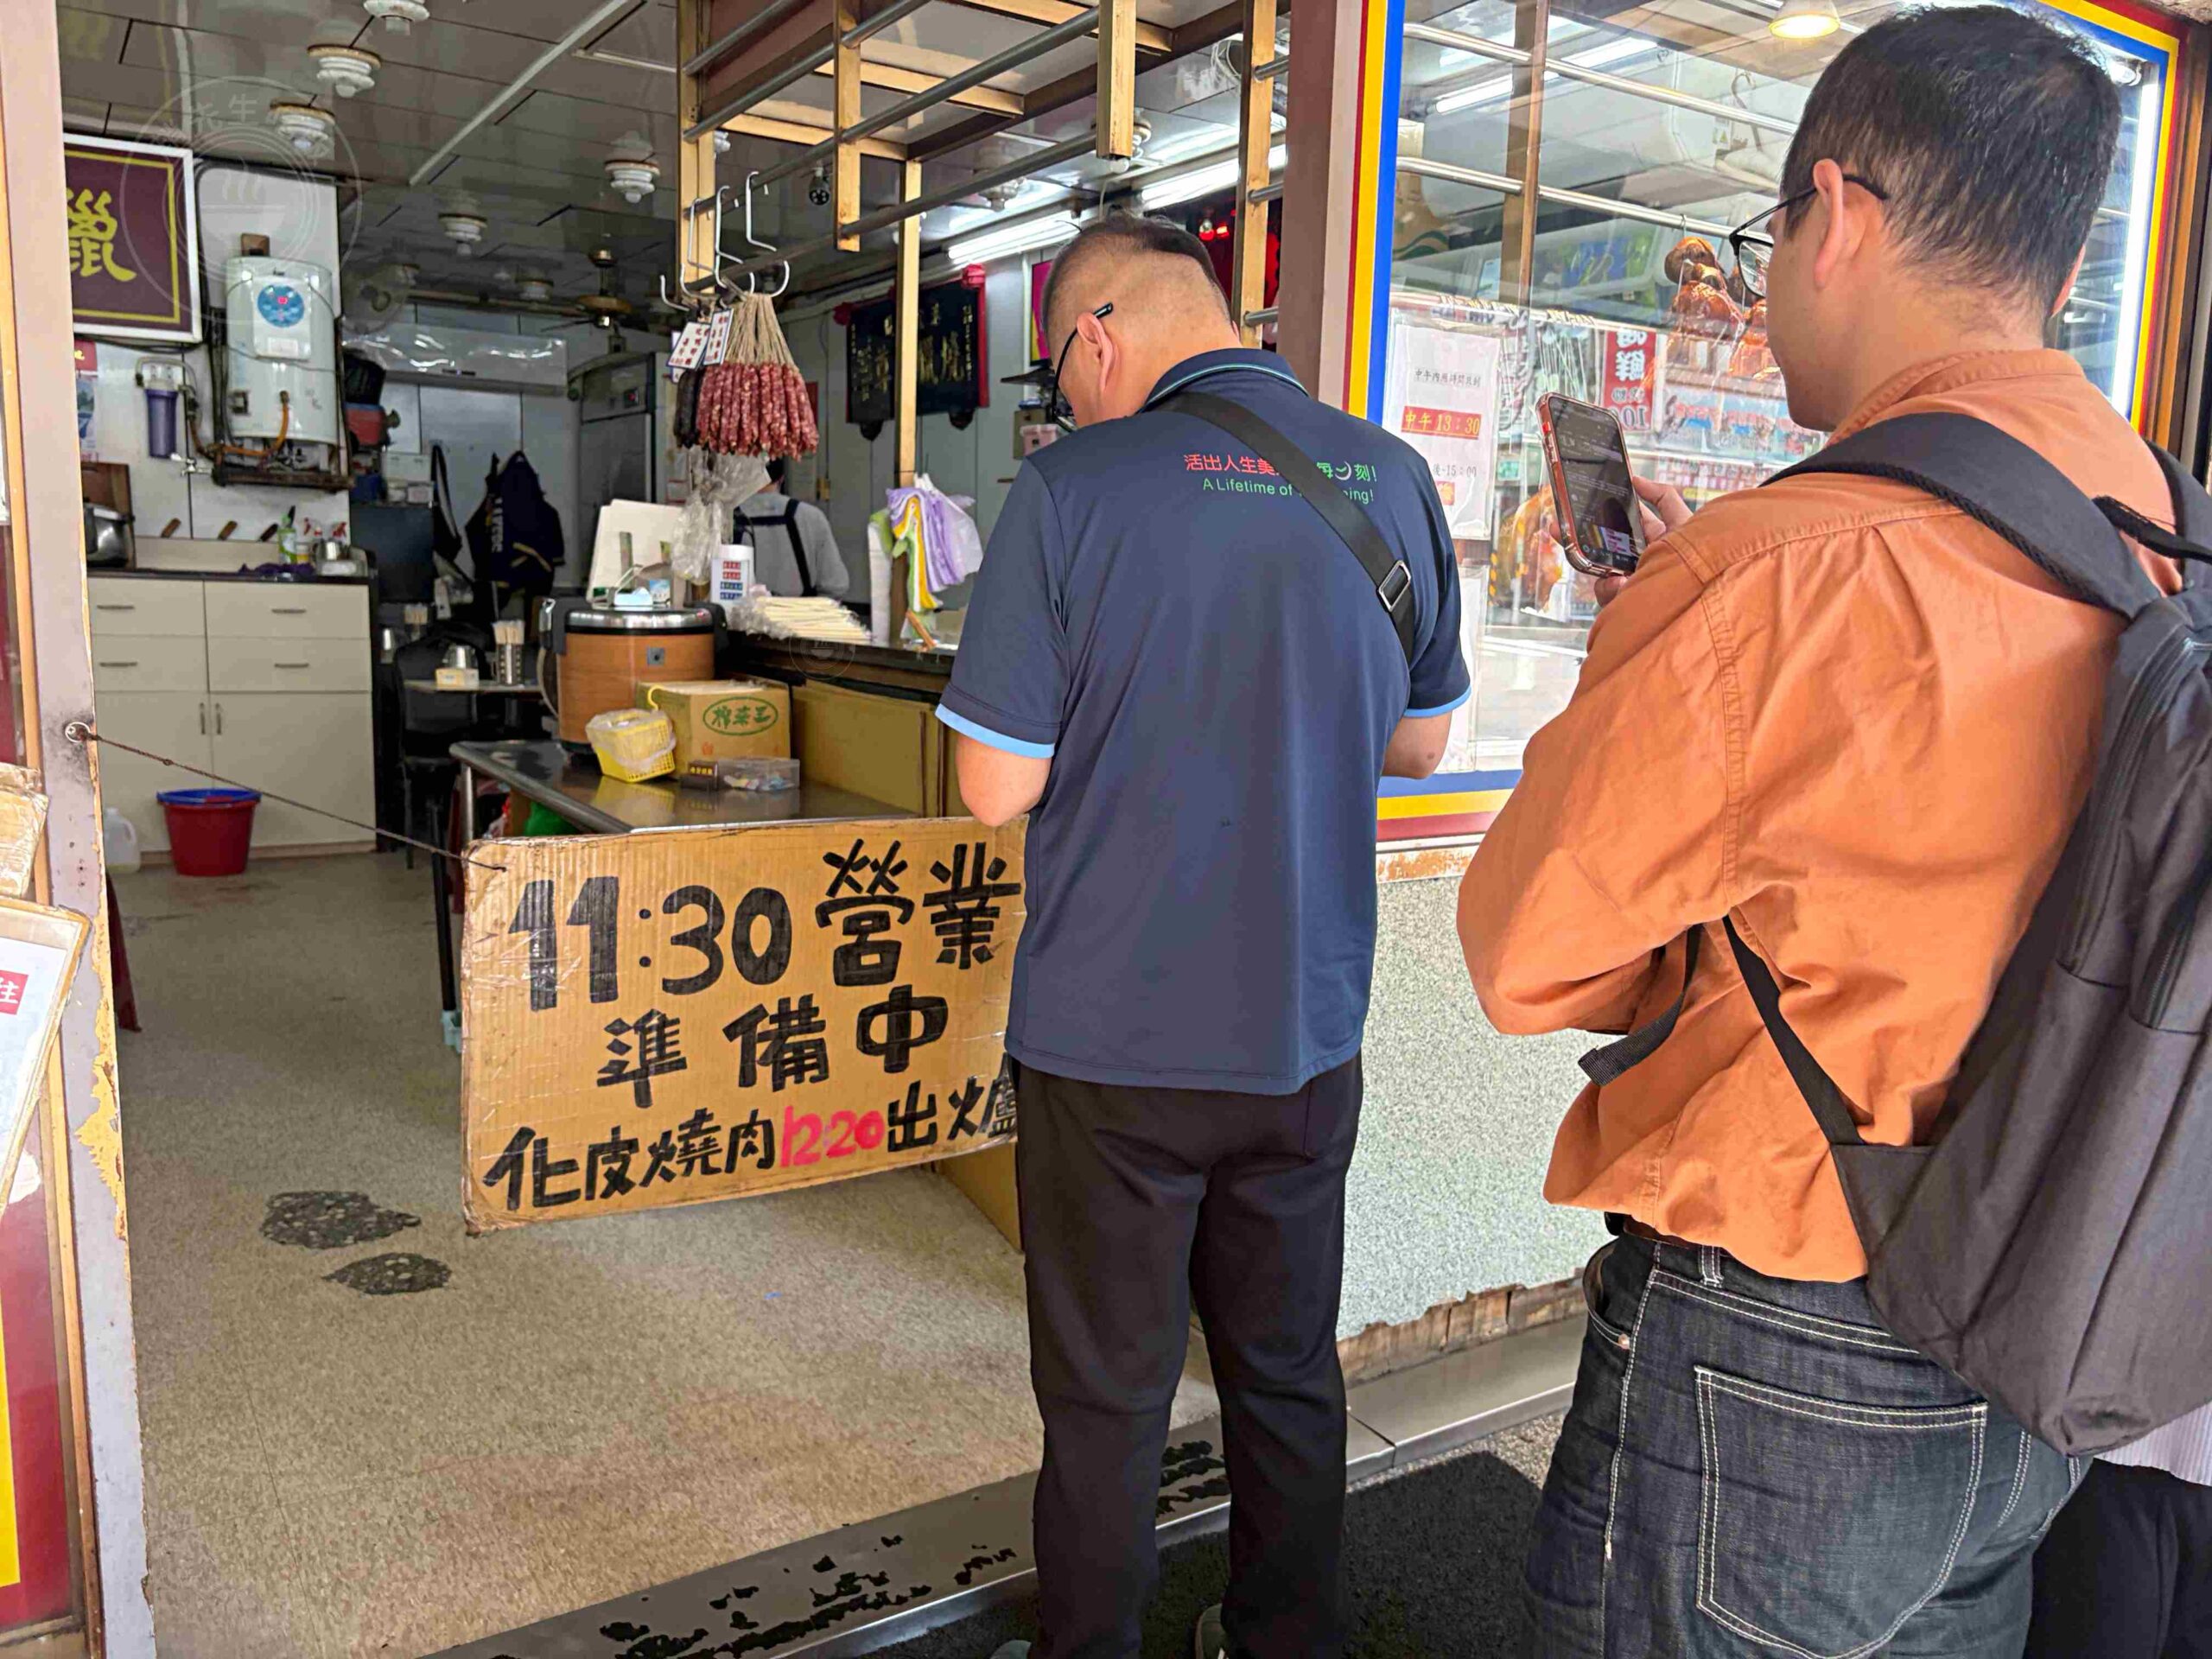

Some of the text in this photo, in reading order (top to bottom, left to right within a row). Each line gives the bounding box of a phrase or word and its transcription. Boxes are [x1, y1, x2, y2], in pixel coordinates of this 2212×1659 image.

[1203, 477, 1294, 496] A Lifetime of
[596, 984, 949, 1109] 準備中
